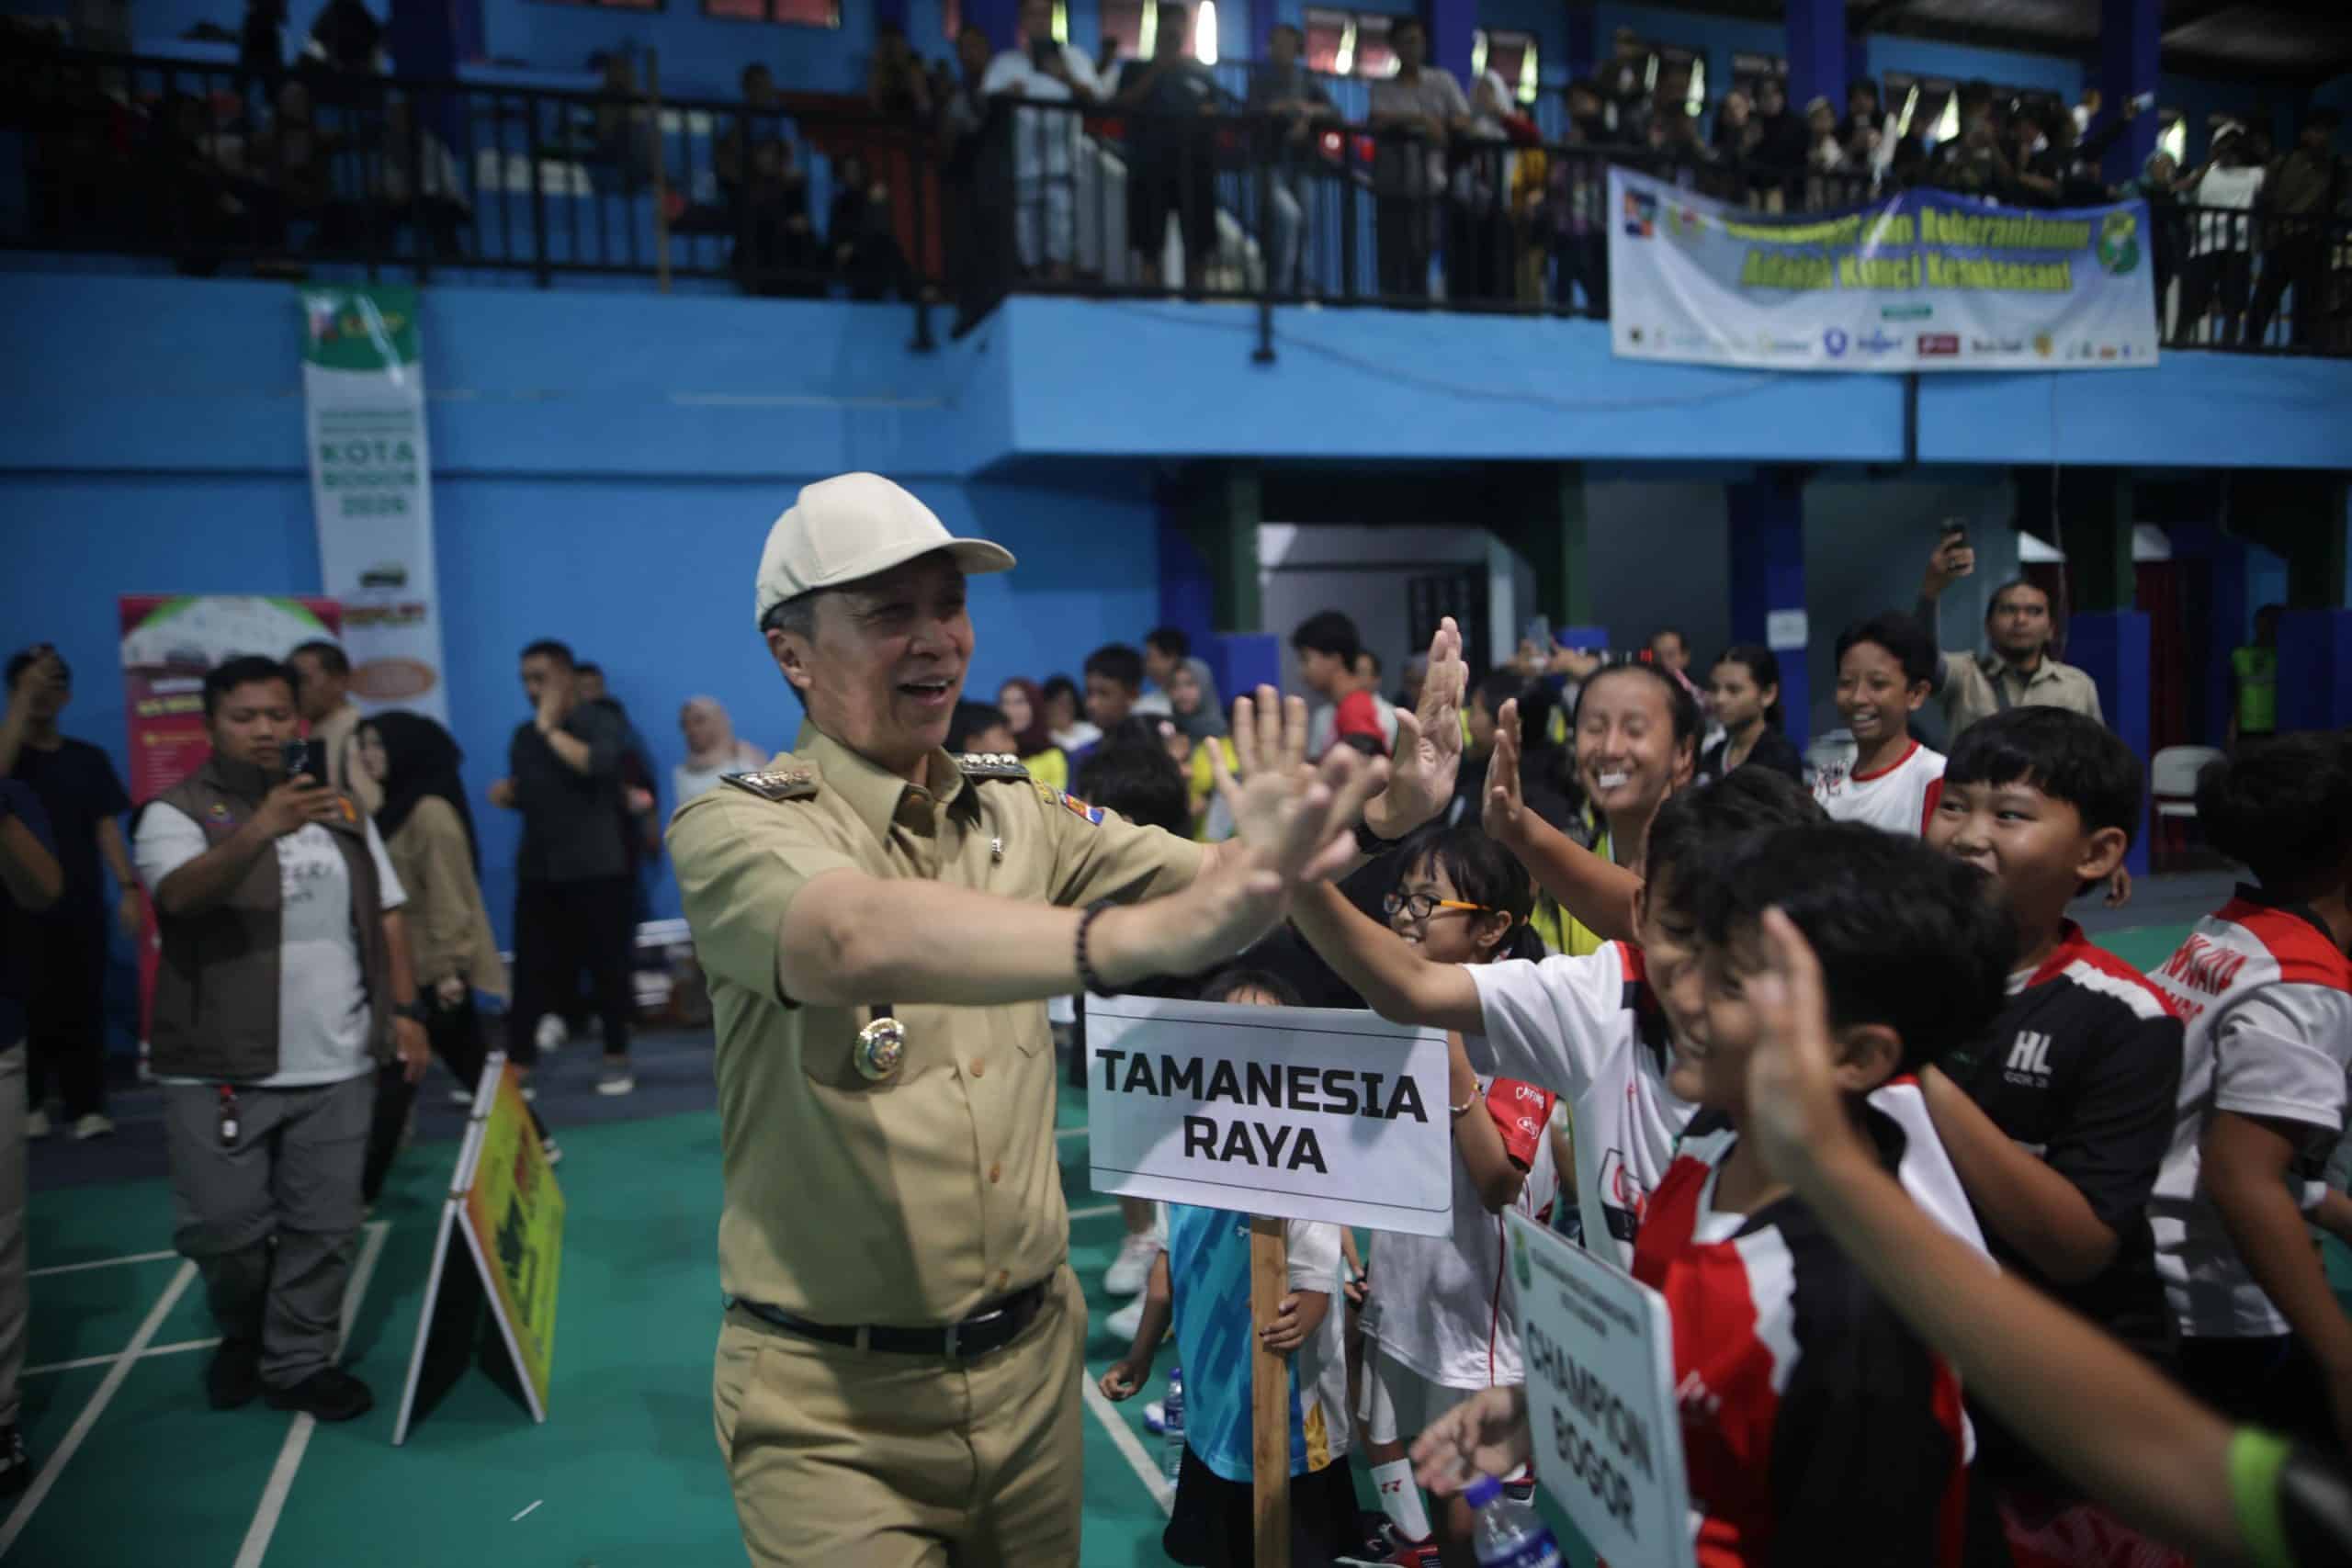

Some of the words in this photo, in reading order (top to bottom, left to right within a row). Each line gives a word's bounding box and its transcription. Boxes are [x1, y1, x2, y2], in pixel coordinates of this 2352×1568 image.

[321, 442, 415, 465] KOTA
[1095, 1048, 1428, 1122] TAMANESIA
[2006, 1030, 2052, 1074] HL
[1184, 1114, 1328, 1174] RAYA
[1526, 1321, 1654, 1483] CHAMPION
[1551, 1406, 1636, 1541] BOGOR
